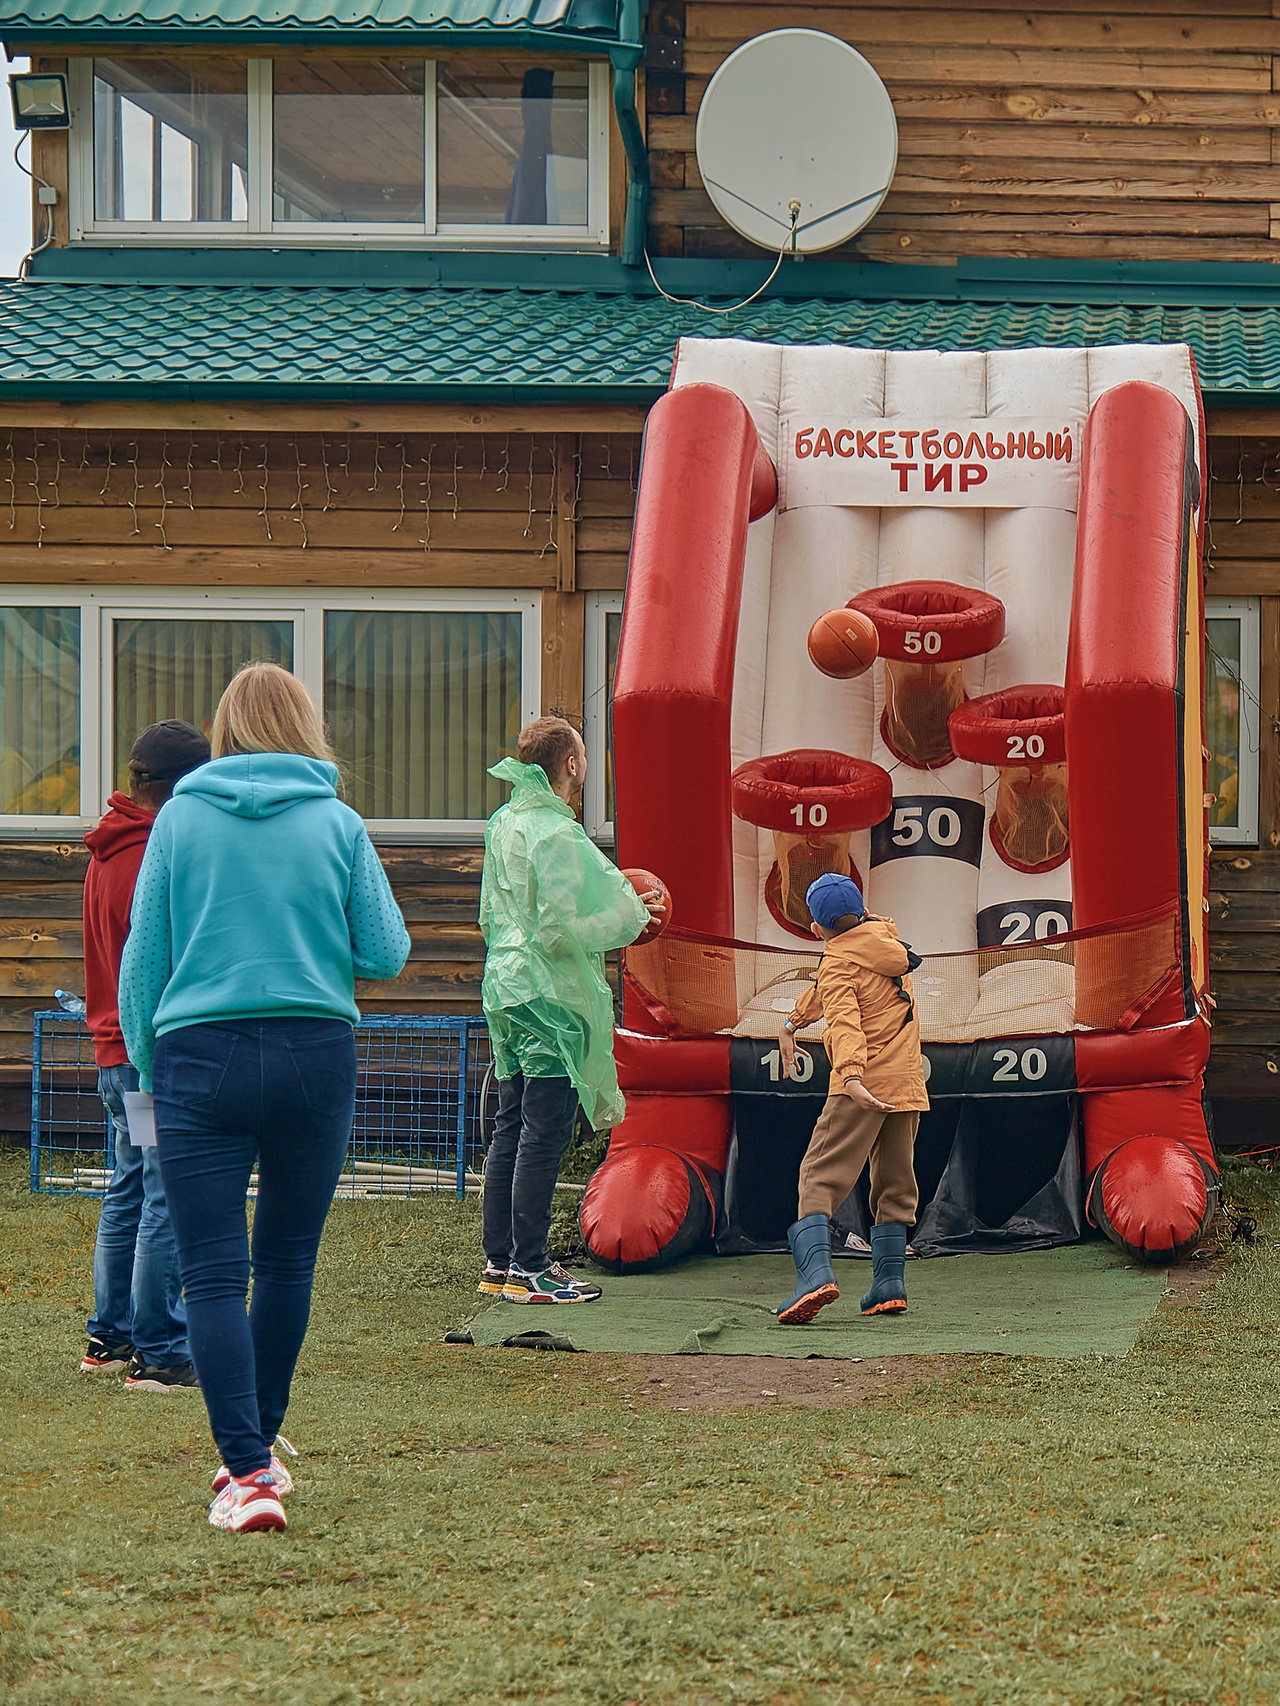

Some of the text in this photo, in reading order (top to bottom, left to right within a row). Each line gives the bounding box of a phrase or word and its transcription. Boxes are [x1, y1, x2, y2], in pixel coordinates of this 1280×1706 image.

[794, 427, 1073, 463] БАСКЕТБОЛЬНЫЙ
[890, 462, 988, 492] ТИР
[903, 631, 942, 655] 50
[1006, 734, 1045, 759] 20
[790, 803, 828, 827] 10
[892, 796, 961, 847] 50
[1000, 911, 1069, 951] 20
[761, 1049, 814, 1083] 10
[993, 1048, 1047, 1081] 20
